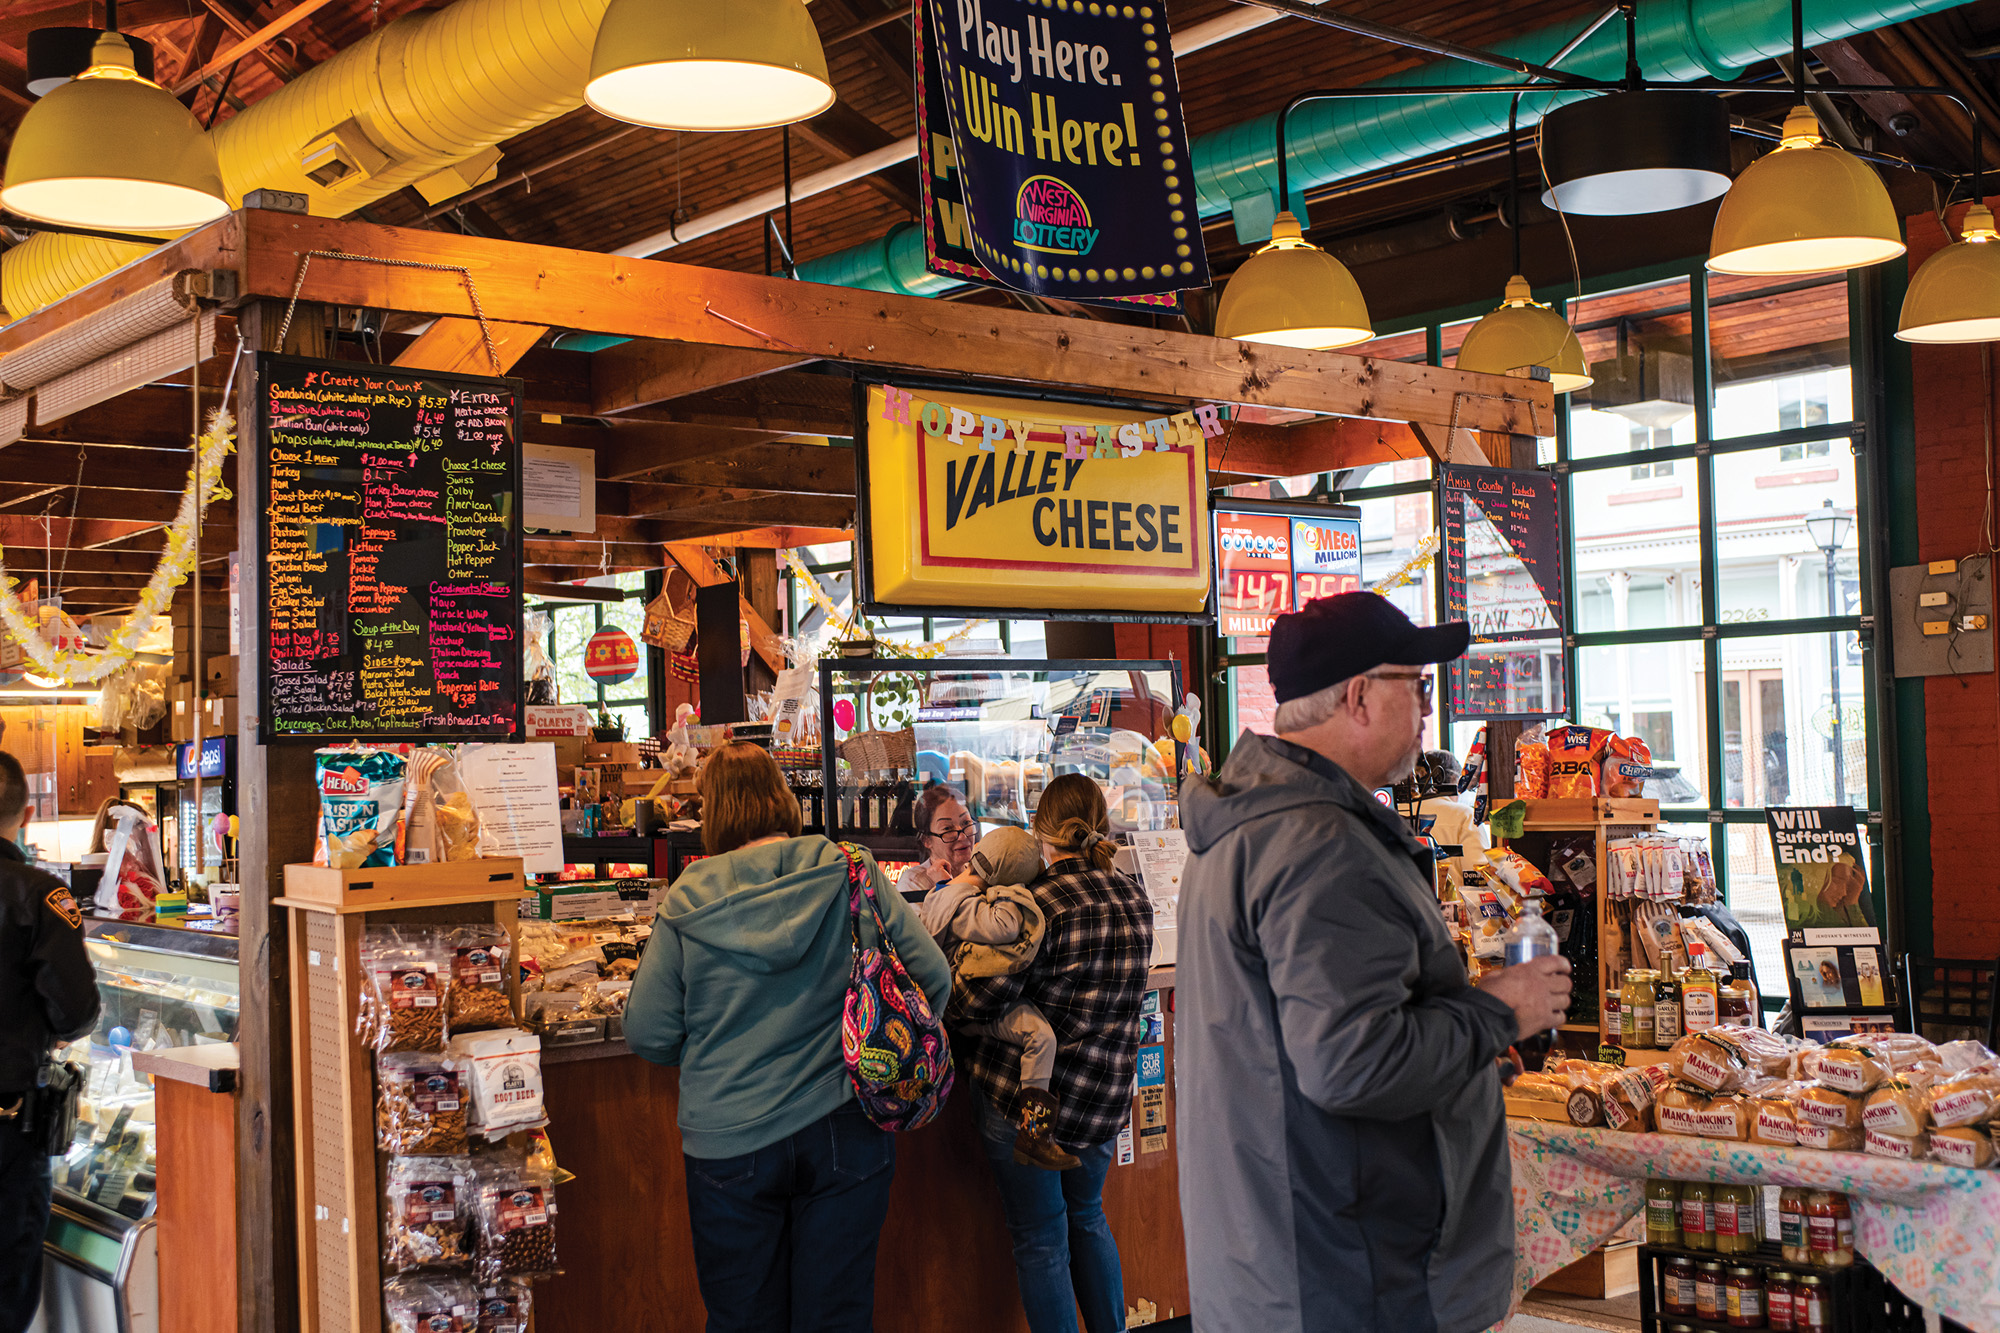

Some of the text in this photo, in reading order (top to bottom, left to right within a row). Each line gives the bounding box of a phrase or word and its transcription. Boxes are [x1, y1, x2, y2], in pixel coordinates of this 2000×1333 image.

[957, 0, 1122, 86] Play Here.
[959, 64, 1025, 156] Win
[1031, 92, 1141, 166] Here!
[1025, 180, 1072, 206] WEST
[1020, 190, 1087, 228] VIRGINIA
[1013, 218, 1100, 255] LOTTERY
[321, 371, 412, 392] Create Your Own
[269, 383, 316, 400] Sandwich
[461, 391, 500, 404] EXTRA
[270, 400, 280, 414] 8
[484, 406, 508, 416] cheese
[305, 418, 323, 431] Bun
[468, 417, 506, 428] ADD BACON
[882, 384, 1225, 460] HOPPY EASTER
[271, 430, 308, 448] Wraps
[269, 447, 340, 466] Choose 1 MEAT
[442, 457, 507, 472] Choose 1 cheese
[269, 464, 300, 481] Turkey
[446, 474, 474, 485] Swiss
[1446, 470, 1536, 497] Amish Country Products
[271, 489, 297, 501] Roast
[417, 488, 439, 498] cheese
[447, 486, 474, 499] Colby
[946, 450, 1085, 532] VALLEY
[270, 501, 325, 514] Corned Beef
[409, 500, 432, 509] cheese
[446, 496, 492, 510] American
[447, 511, 507, 524] Bacon Cheddar
[271, 524, 308, 537] Pastrami
[447, 523, 487, 538] Provolone
[1032, 497, 1184, 554] CHEESE
[359, 526, 397, 540] Toppings
[1316, 527, 1357, 550] MEGA
[271, 538, 309, 552] Bologna
[349, 538, 384, 552] Lettuce
[447, 539, 500, 555] Pepper Jack
[347, 553, 379, 564] Tomato
[447, 554, 495, 568] Hot Pepper
[1314, 551, 1358, 564] MILLIONS
[270, 561, 328, 573] Chicken Breast
[350, 563, 376, 575] Pickle
[270, 572, 302, 584] Salami
[270, 584, 313, 599] Egg Salad
[350, 582, 379, 594] Banana
[1236, 573, 1289, 611] 147
[270, 596, 325, 608] Chicken Salad
[348, 593, 372, 604] Green
[430, 596, 456, 609] Mayo
[269, 606, 316, 618] Tuna Salad
[348, 603, 395, 613] Cucumber
[430, 609, 488, 619] Miracle Whip
[1721, 608, 1769, 624] 2263
[271, 617, 317, 630] Ham Salad
[353, 618, 420, 635] Soup Day
[429, 620, 461, 632] Mustard
[1228, 617, 1276, 631] MILLIO
[270, 632, 312, 648] Hot Dog
[429, 633, 464, 646] Ketchup
[270, 647, 315, 660] Chili Dog
[429, 647, 491, 661] Italian Dressing
[272, 659, 312, 671] Salads
[433, 659, 479, 668] Horseradish
[394, 668, 415, 677] Salad
[434, 668, 459, 680] Ranch
[270, 674, 328, 687] Tossed Salad
[362, 679, 405, 689] Pasta Salad
[271, 685, 317, 696] Chef Salad
[364, 690, 388, 699] Baked
[411, 687, 431, 696] Salad
[436, 679, 500, 696] Pepperoni Rolls
[300, 693, 323, 703] Salad
[378, 696, 419, 707] Cole Slaw
[331, 703, 354, 713] Salad
[423, 711, 473, 727] Fresh Brewed
[537, 717, 573, 728] CLAEYS
[1566, 735, 1589, 744] WISE
[610, 763, 628, 773] DAY
[1550, 760, 1593, 776] BBQ
[1771, 810, 1821, 830] Will
[1775, 830, 1857, 846] Suffering
[1778, 844, 1843, 864] End?
[1142, 1053, 1153, 1061] THIS
[1141, 1059, 1160, 1070] OUR
[1142, 1068, 1161, 1076] WATCH
[494, 1089, 536, 1104] ROOT BEER
